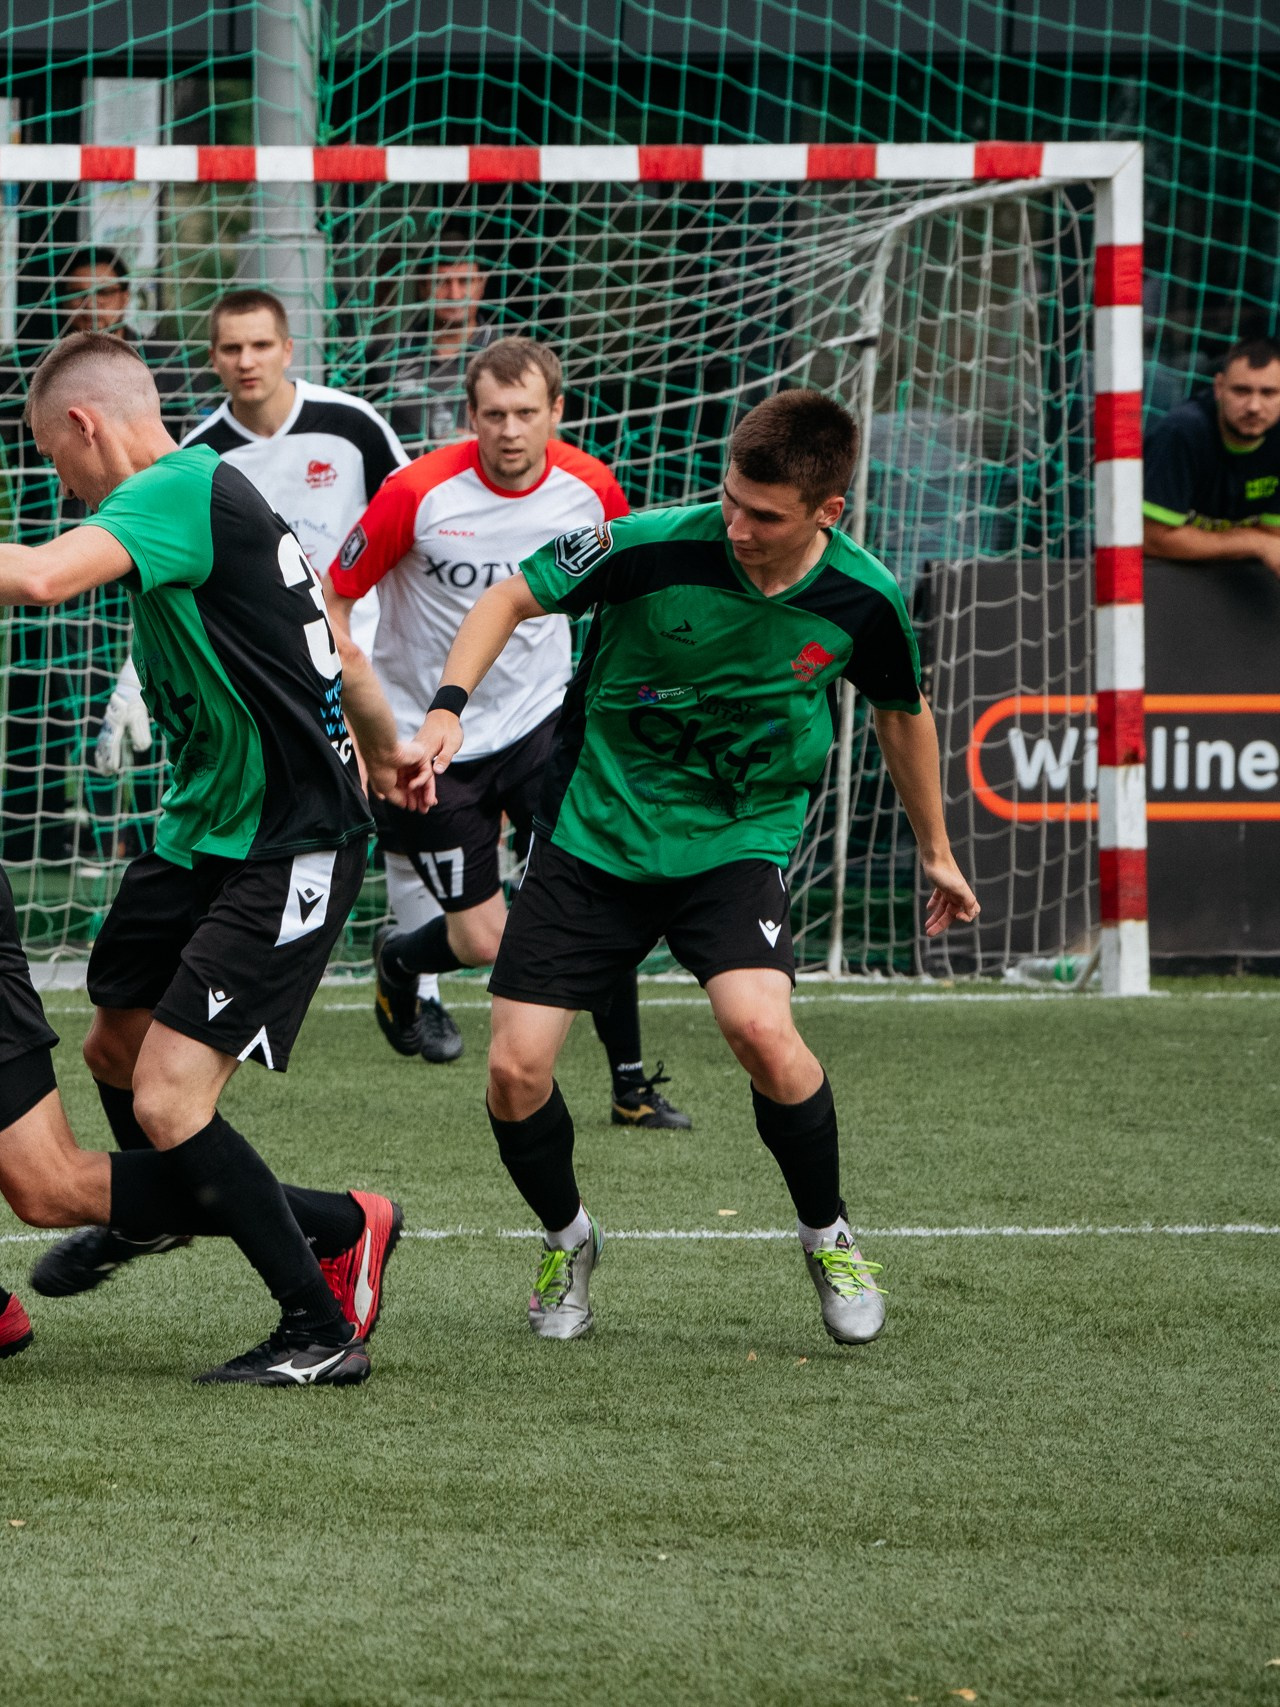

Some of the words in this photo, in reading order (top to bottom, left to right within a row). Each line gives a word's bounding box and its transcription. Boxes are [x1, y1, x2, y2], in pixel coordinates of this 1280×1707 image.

[659, 629, 698, 646] DEMIX
[1007, 726, 1280, 790] Wiline
[418, 846, 465, 899] 17
